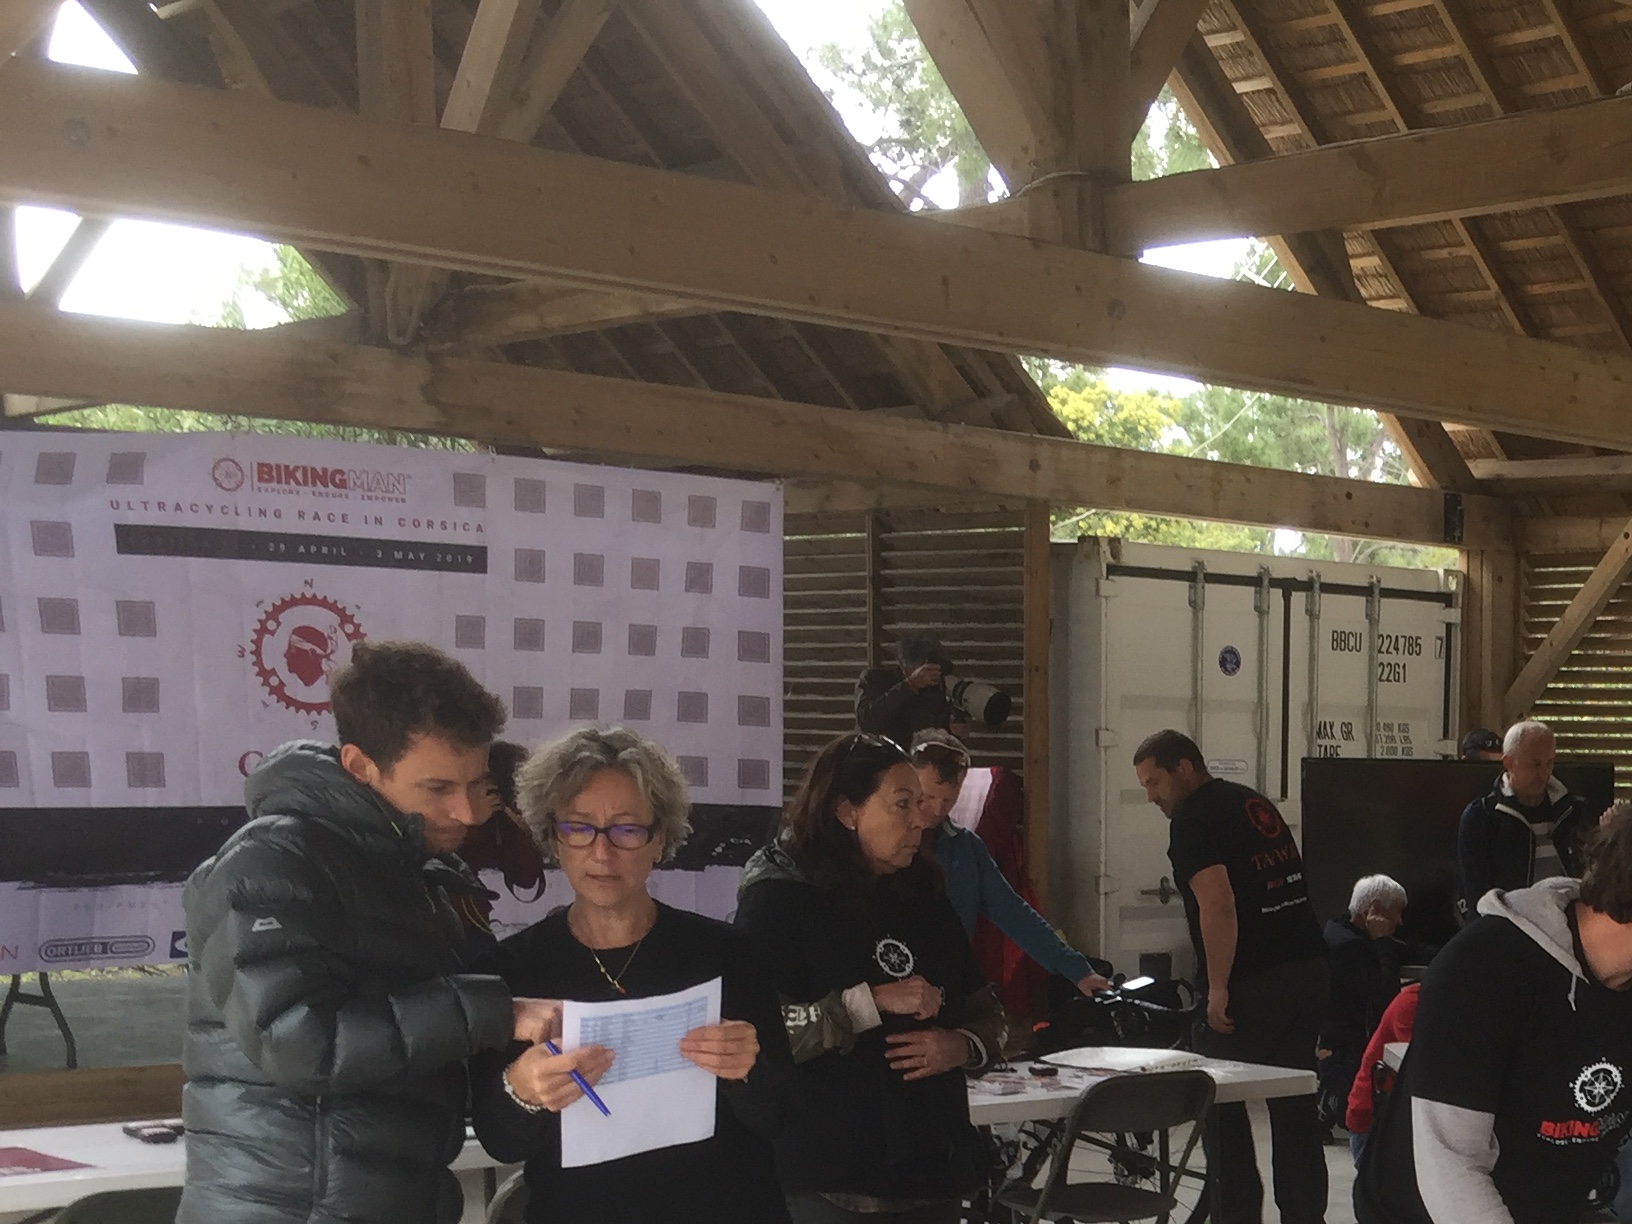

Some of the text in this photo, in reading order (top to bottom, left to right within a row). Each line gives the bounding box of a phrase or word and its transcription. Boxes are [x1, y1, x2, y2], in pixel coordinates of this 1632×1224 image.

[256, 462, 406, 495] BIKINGMAN
[110, 500, 485, 534] ULTRACYCLING RACE IN CORSICA
[298, 545, 348, 557] APRIL
[392, 549, 426, 561] MAY
[436, 552, 475, 564] 2019
[1331, 630, 1363, 653] BBCU
[1377, 634, 1422, 656] 224785
[1378, 662, 1407, 683] 22G1
